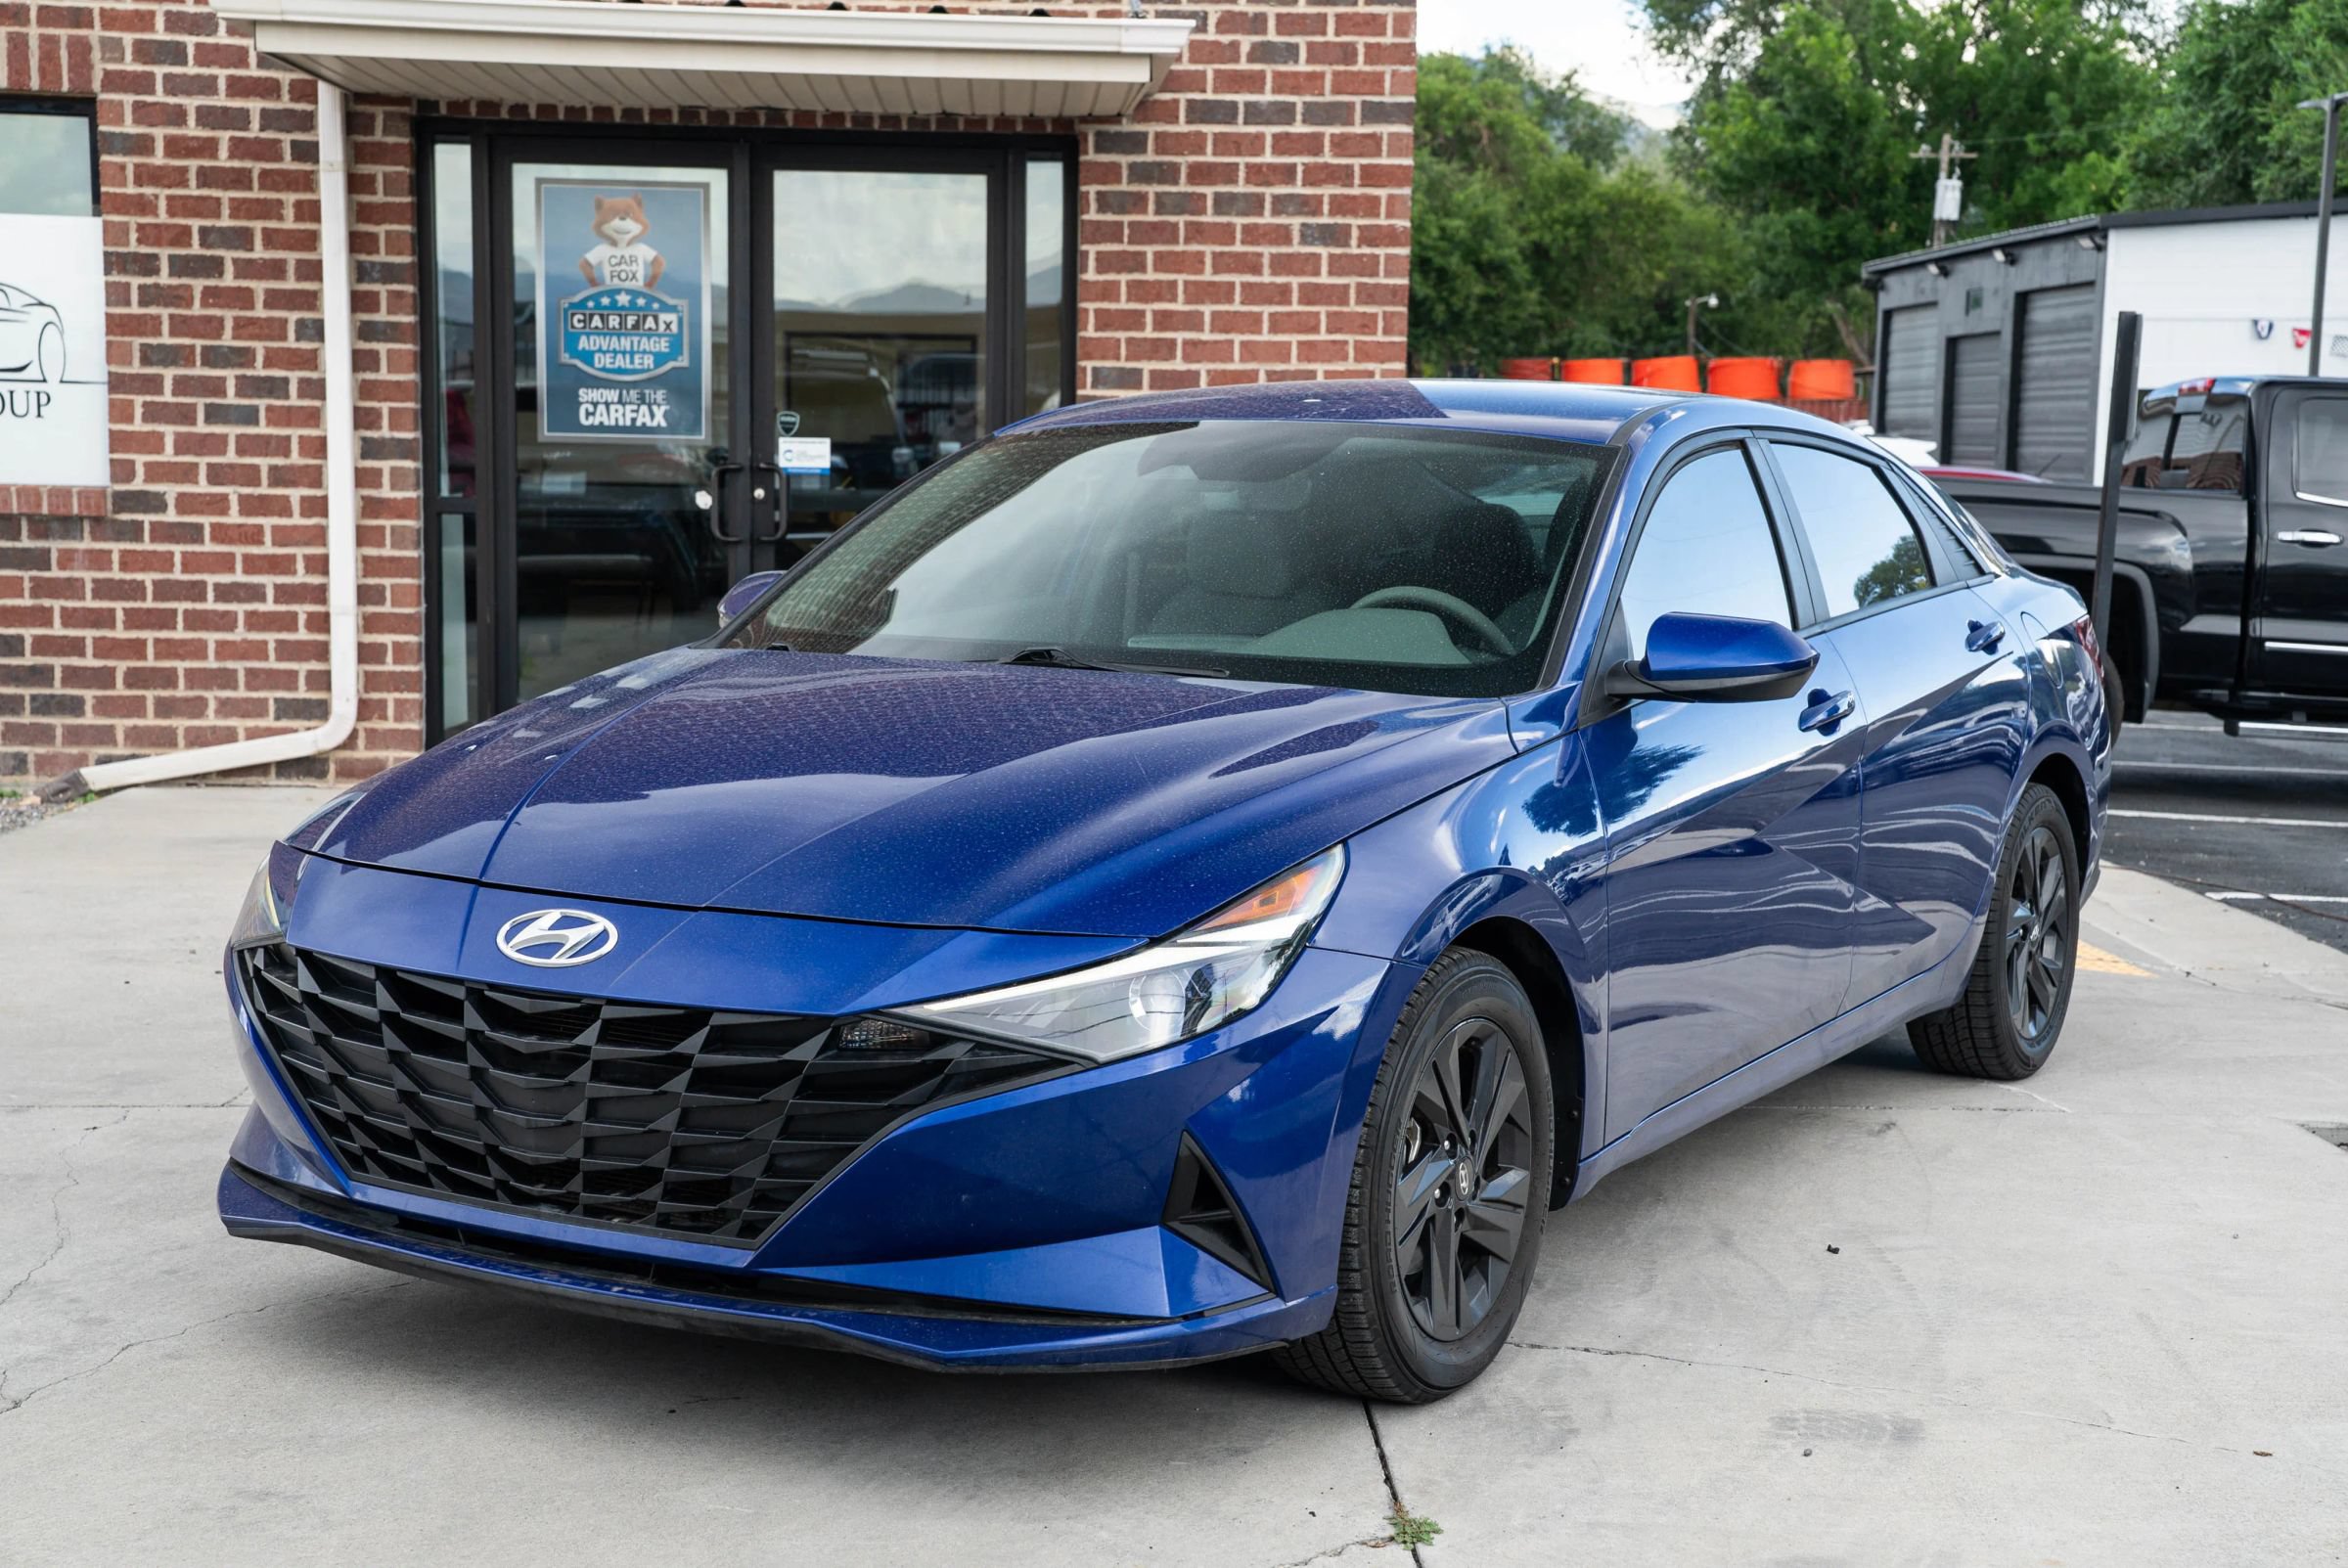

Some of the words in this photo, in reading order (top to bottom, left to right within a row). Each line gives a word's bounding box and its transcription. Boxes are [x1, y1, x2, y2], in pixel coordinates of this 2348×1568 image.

[608, 254, 640, 268] CAR
[610, 269, 639, 283] FOX
[571, 313, 674, 333] CARFAX
[577, 335, 670, 353] ADVANTAGE
[594, 352, 655, 370] DEALER
[578, 387, 620, 403] SHOW
[621, 389, 642, 404] ME
[643, 389, 668, 404] THE
[578, 403, 670, 427] CARFAX
